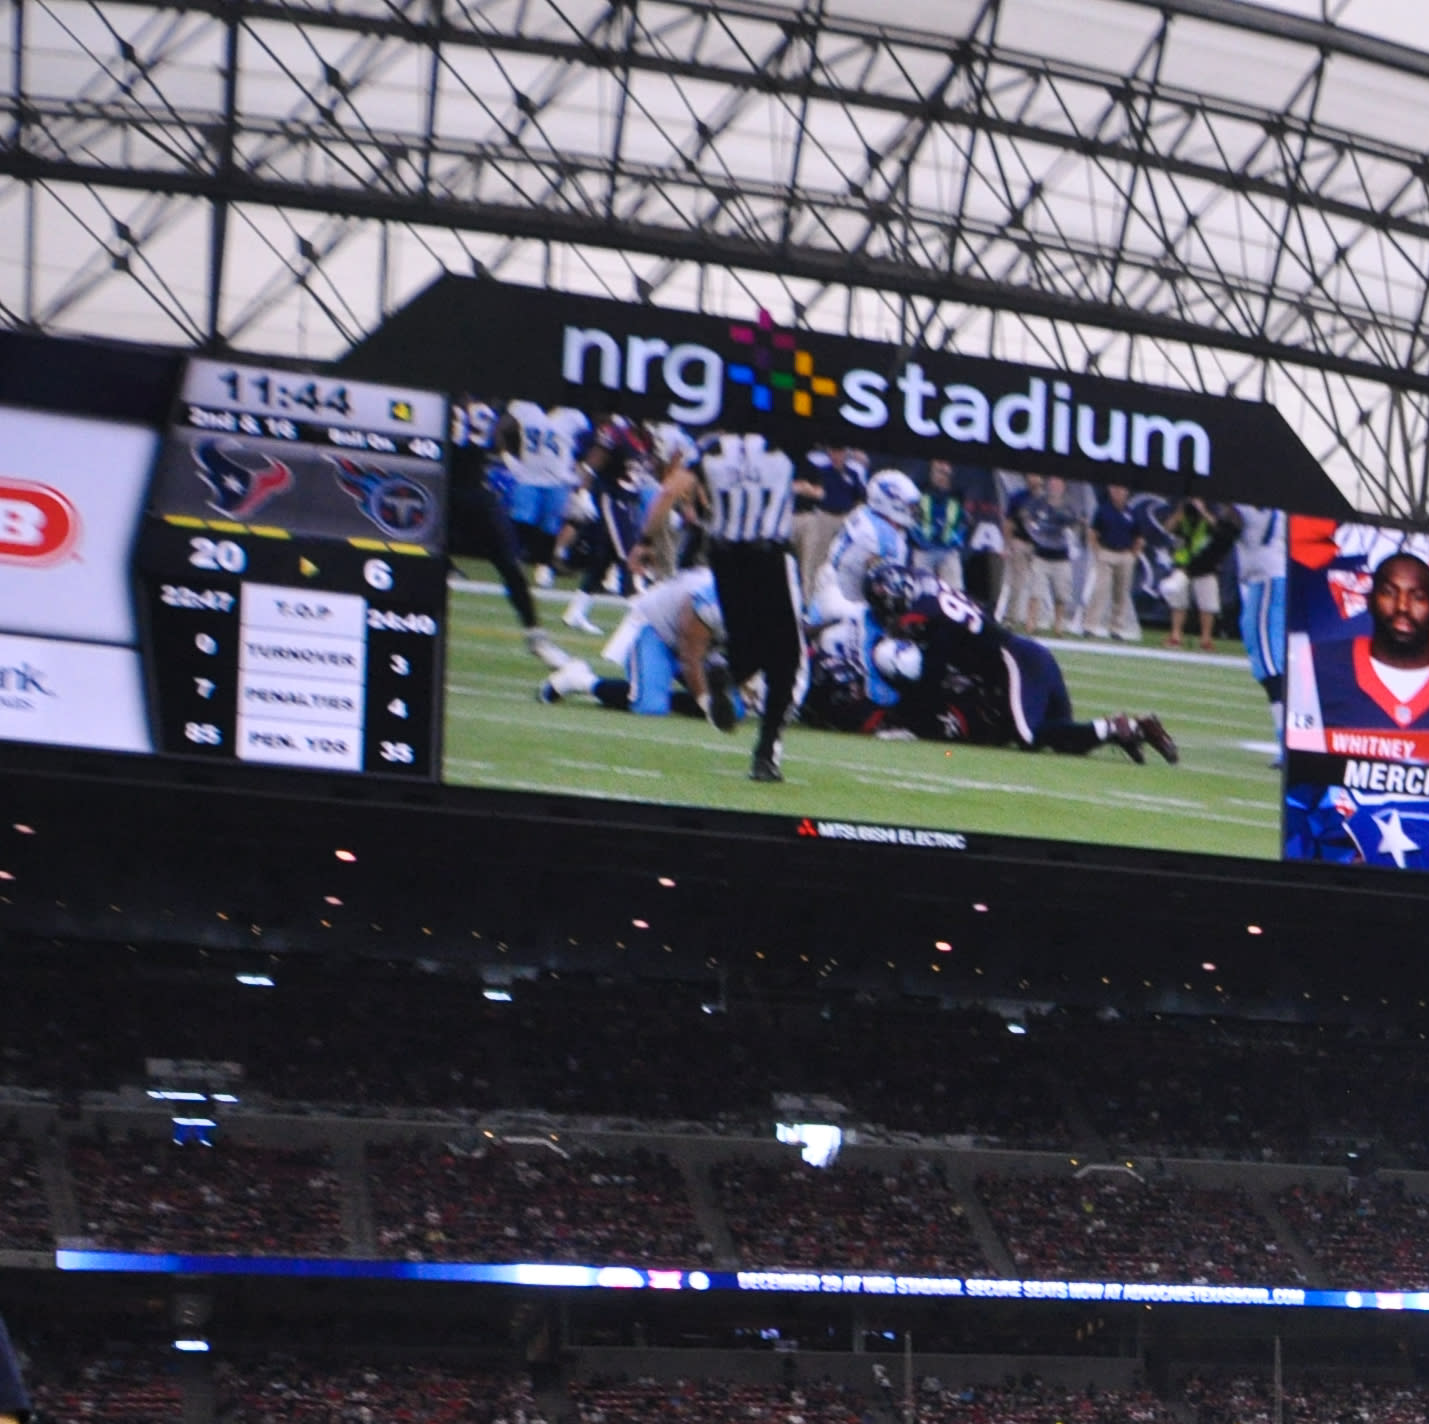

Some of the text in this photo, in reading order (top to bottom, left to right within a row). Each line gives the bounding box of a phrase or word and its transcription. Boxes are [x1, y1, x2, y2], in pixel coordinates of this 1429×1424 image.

[219, 369, 352, 416] 11:44
[562, 325, 1210, 476] nrg stadium
[408, 436, 442, 461] 40
[188, 536, 395, 591] 20 6
[244, 687, 355, 713] PENALTIES
[1331, 731, 1417, 758] WHITNEY
